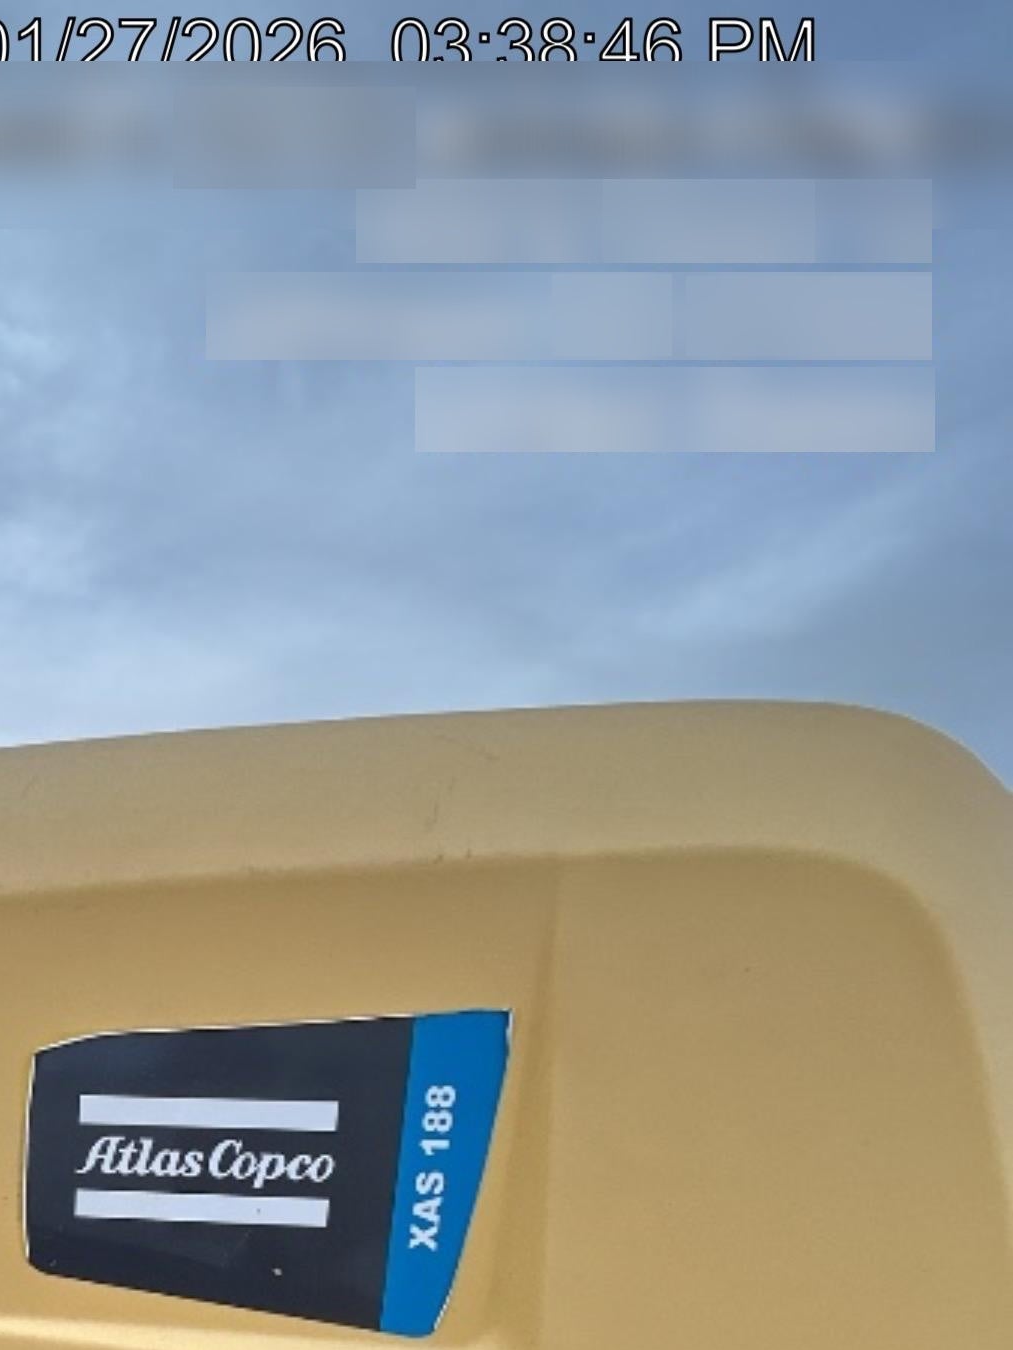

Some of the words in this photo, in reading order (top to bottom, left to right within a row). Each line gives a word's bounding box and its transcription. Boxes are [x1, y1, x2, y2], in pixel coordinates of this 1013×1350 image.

[420, 1085, 456, 1155] 188
[75, 1135, 202, 1179] Atlas
[208, 1137, 336, 1189] Copco
[409, 1171, 444, 1250] XAS
